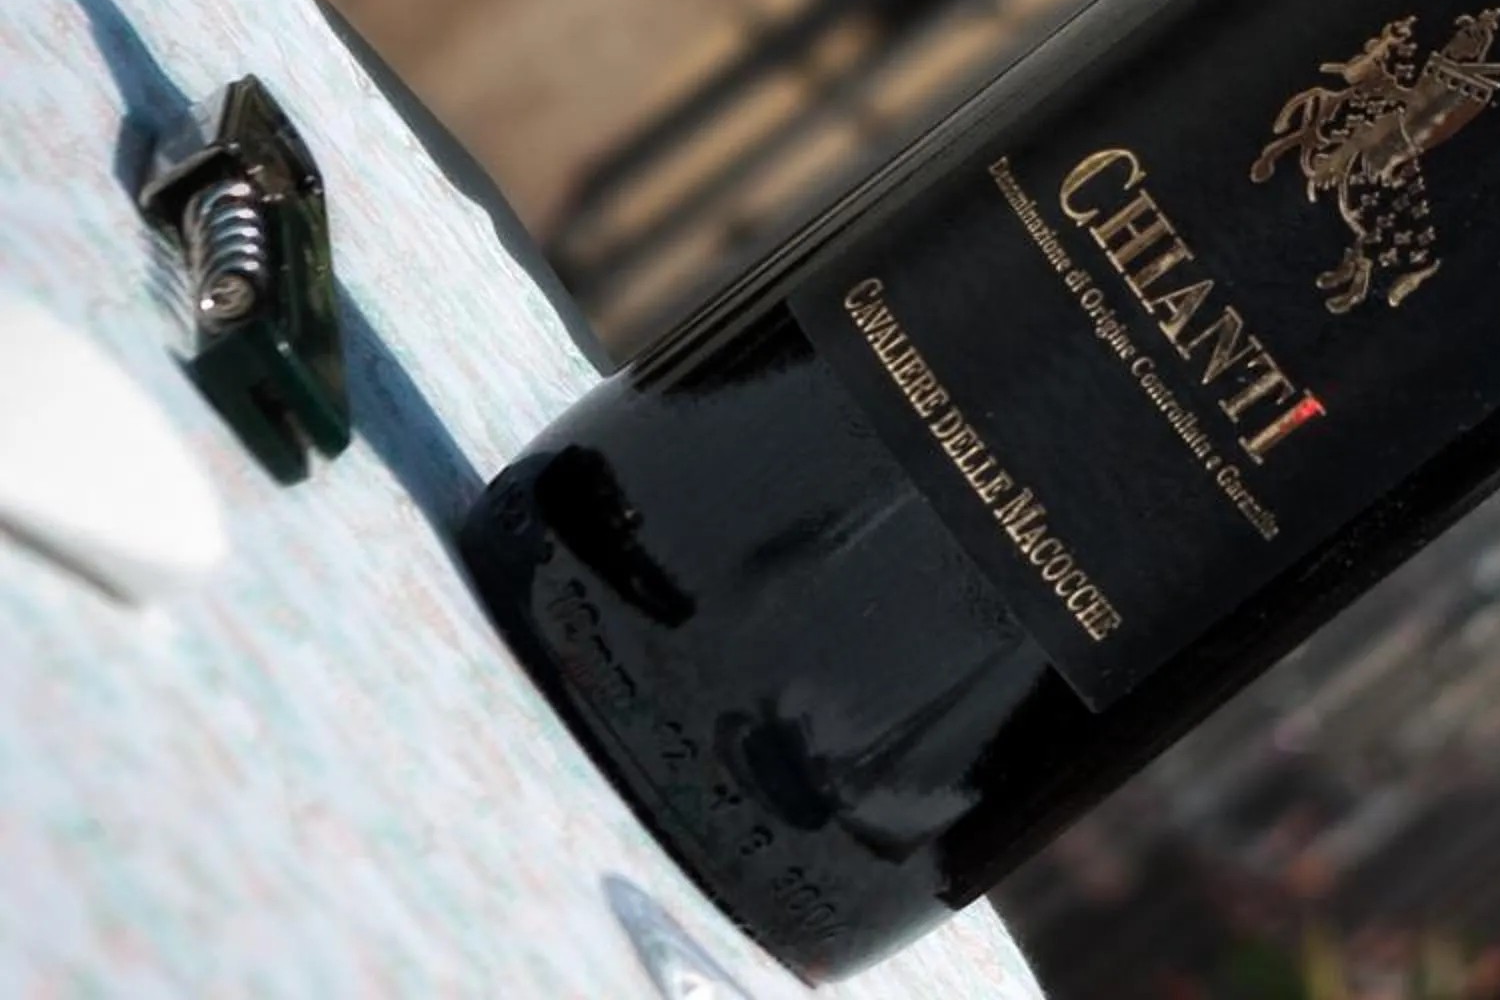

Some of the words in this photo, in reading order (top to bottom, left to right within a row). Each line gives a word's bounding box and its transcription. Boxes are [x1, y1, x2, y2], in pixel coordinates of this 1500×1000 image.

[844, 278, 950, 419] CAVALIERE
[928, 405, 1015, 505] DELLE
[992, 486, 1125, 642] MACOCCHE
[1059, 149, 1327, 464] CHIANTI
[1064, 268, 1093, 293] di
[1080, 287, 1136, 360] Origine
[1131, 356, 1212, 459] Controllata
[1205, 455, 1222, 470] e
